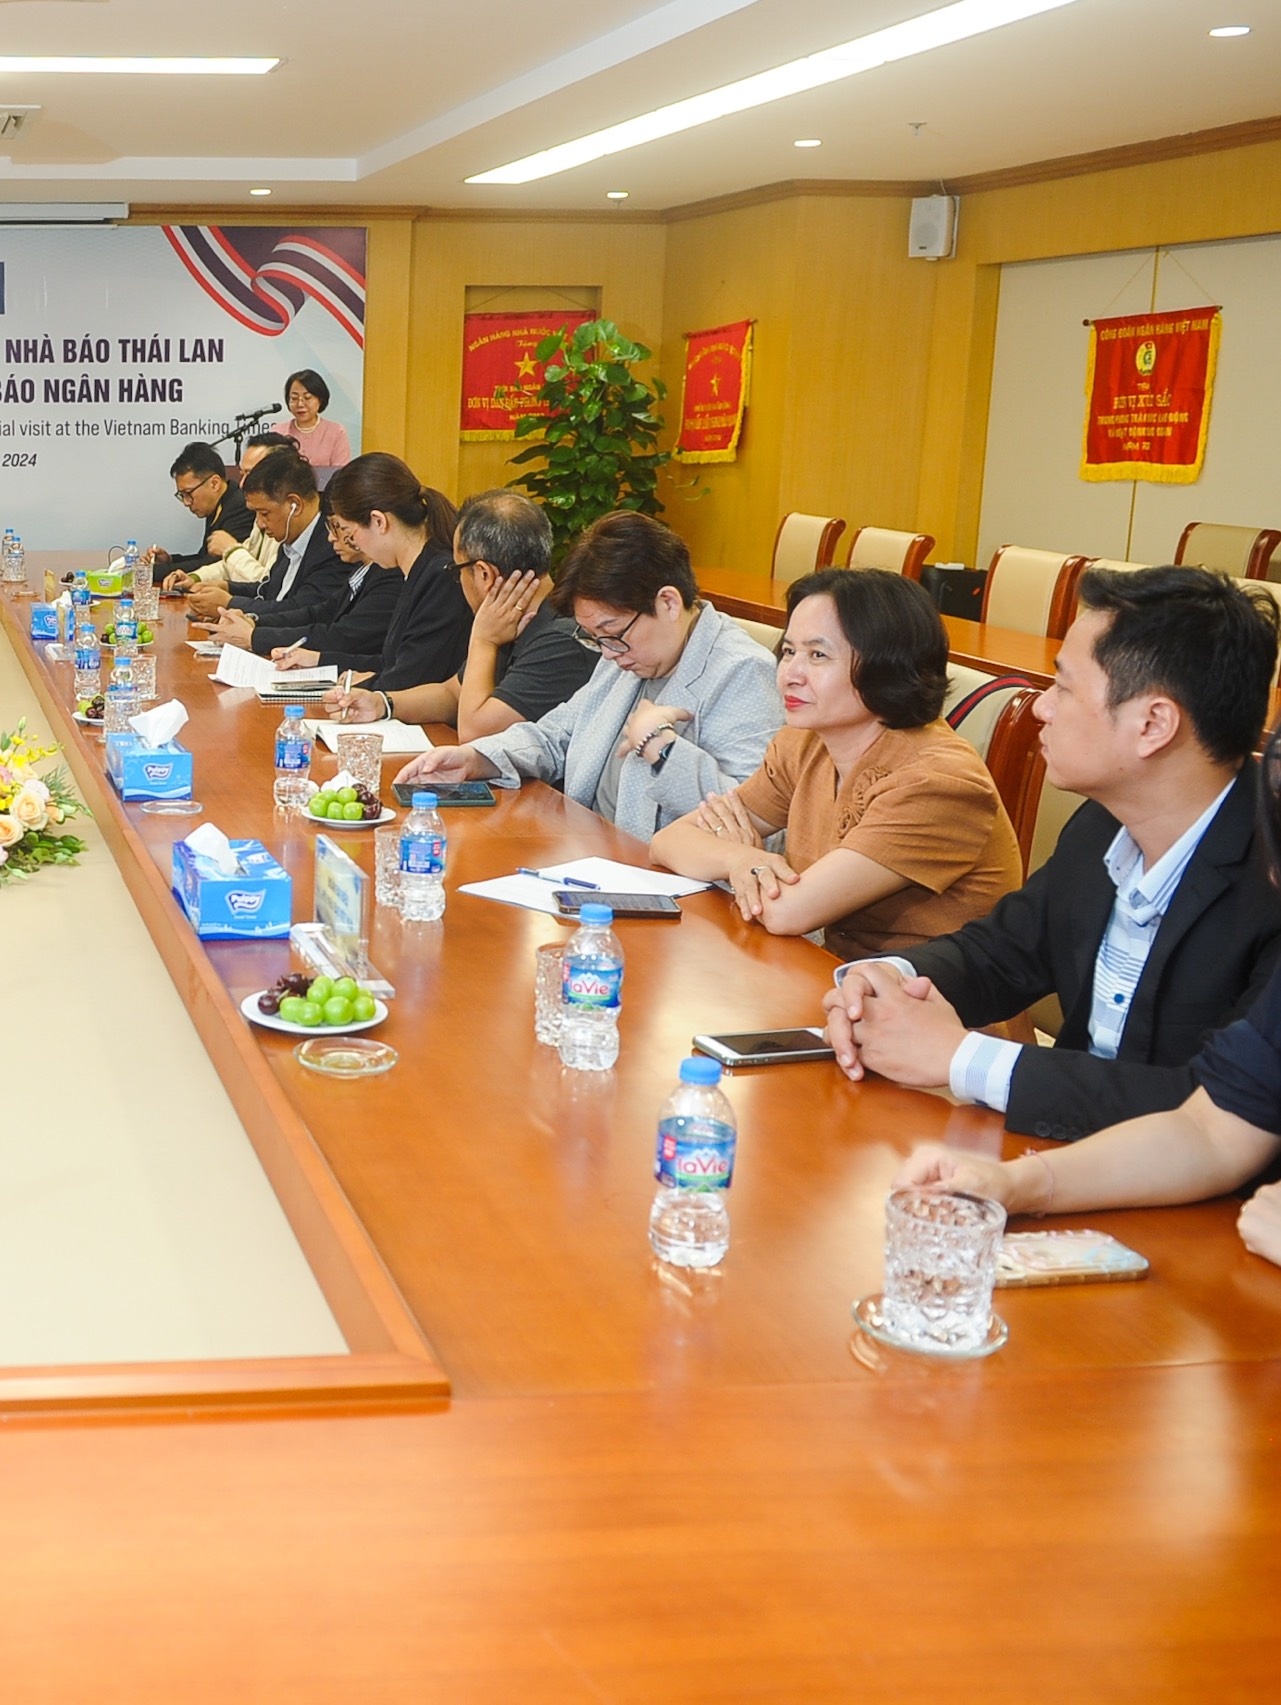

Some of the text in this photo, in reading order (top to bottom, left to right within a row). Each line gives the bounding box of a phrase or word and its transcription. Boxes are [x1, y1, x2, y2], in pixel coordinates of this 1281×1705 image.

[5, 334, 56, 364] NHÀ
[62, 333, 111, 363] BÁO
[118, 333, 171, 363] THÁI
[178, 338, 224, 363] LAN
[43, 373, 110, 403] NGÂN
[118, 373, 183, 403] HÀNG
[19, 419, 52, 437] visit
[55, 420, 71, 437] at
[75, 419, 100, 437] the
[104, 418, 166, 436] Vietnam
[170, 418, 229, 440] Banking
[1, 453, 38, 467] 2024
